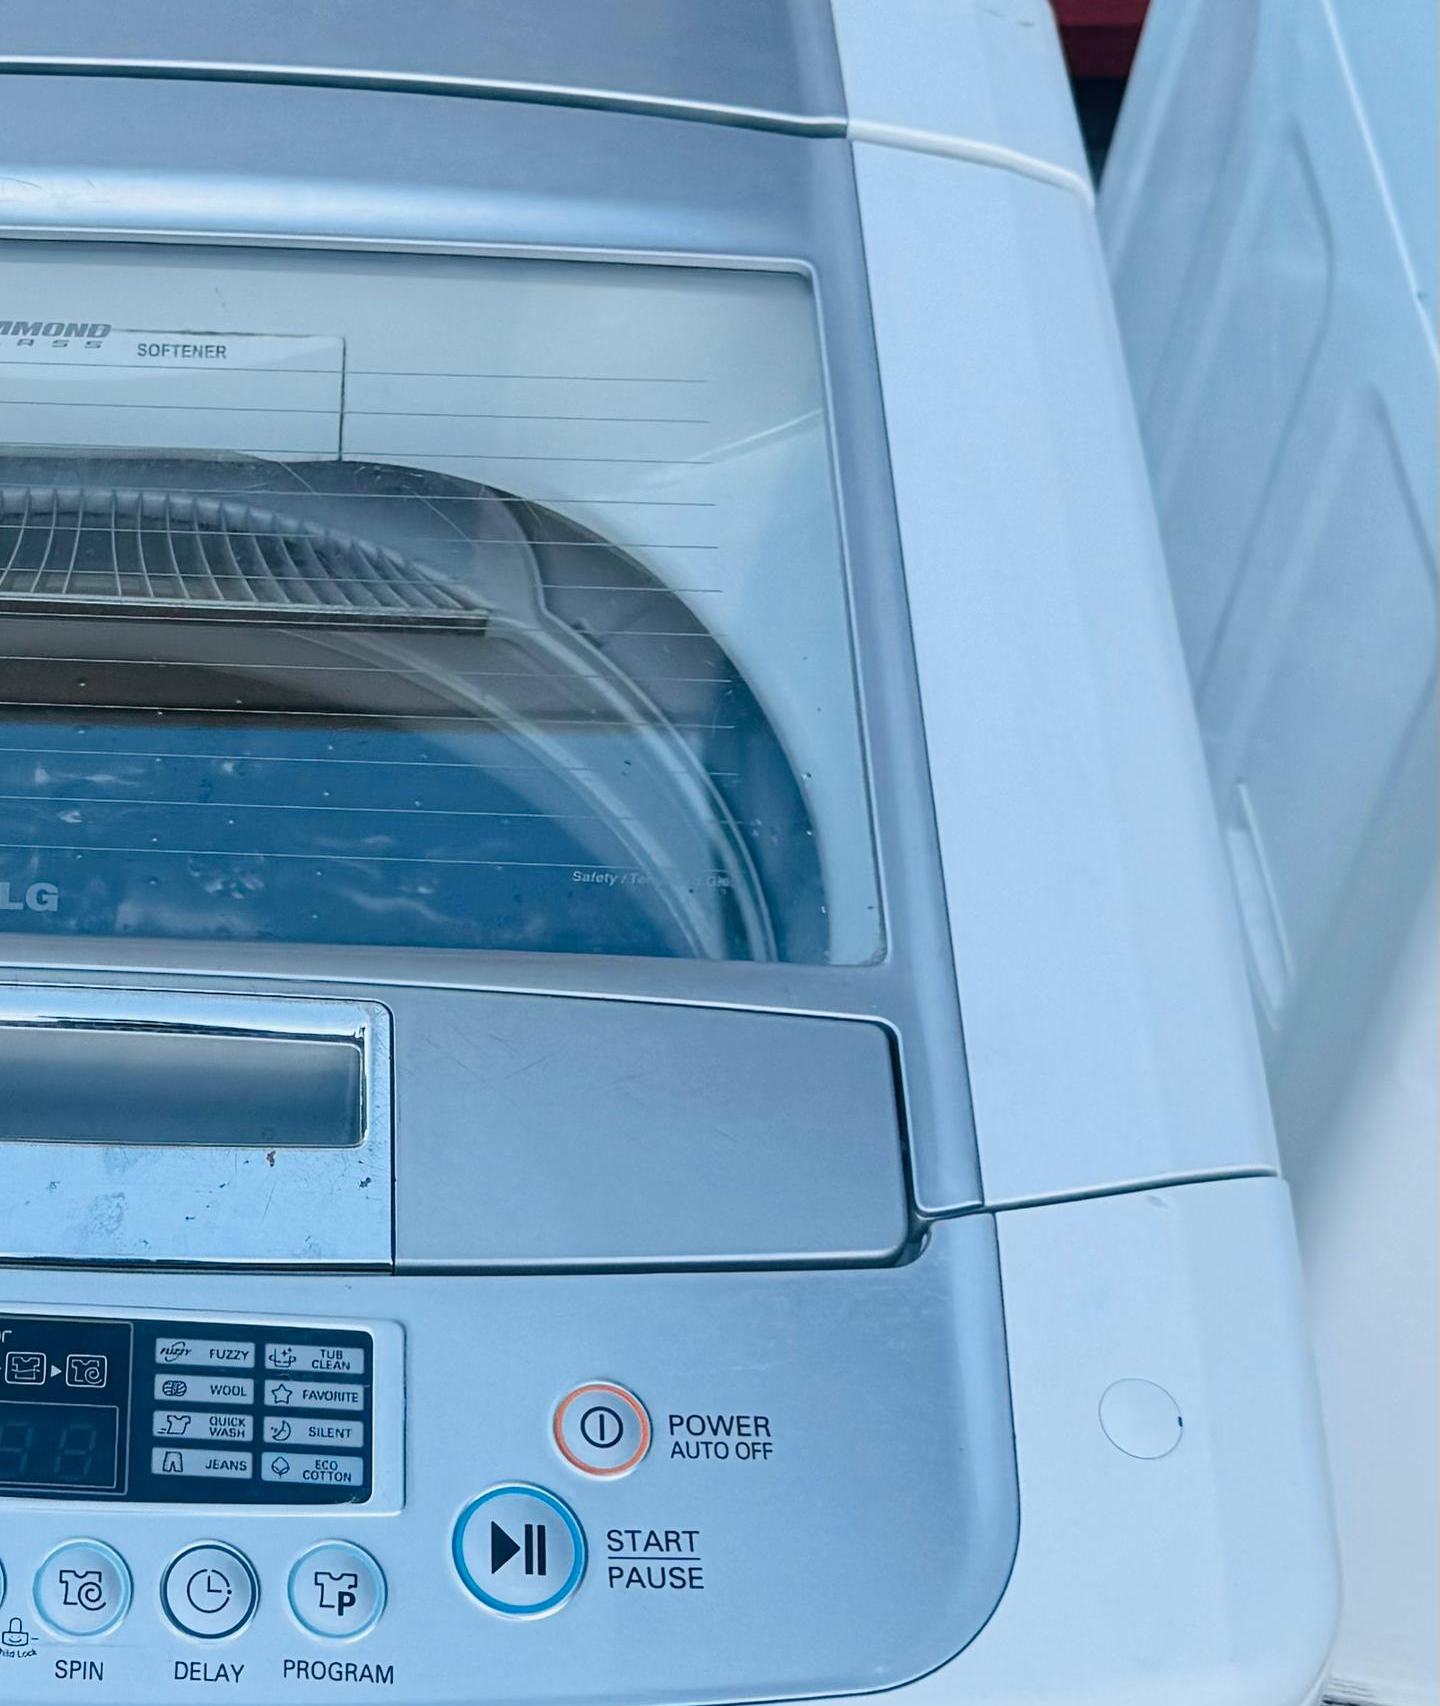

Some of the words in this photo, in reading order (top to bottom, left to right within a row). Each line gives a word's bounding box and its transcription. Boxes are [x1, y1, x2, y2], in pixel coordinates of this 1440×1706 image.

[137, 343, 227, 360] SOFTENER
[209, 1348, 249, 1361] FUZZY
[320, 1349, 344, 1359] TUB
[311, 1359, 351, 1371] CLEAN
[210, 1384, 247, 1397] WOOL
[301, 1390, 359, 1404] FAVORITE
[208, 1415, 246, 1428] QUICK
[668, 1414, 771, 1438] POWER
[208, 1426, 246, 1439] WASH
[308, 1426, 352, 1439] SILENT
[670, 1441, 729, 1460] AUTO
[735, 1442, 774, 1461] OFF
[205, 1459, 248, 1472] JEANS
[315, 1460, 338, 1471] ECO
[302, 1471, 352, 1483] COTTON
[606, 1529, 701, 1553] START
[607, 1566, 705, 1590] PAUSE
[54, 1660, 104, 1681] SPIN
[174, 1661, 245, 1684] DELAY
[283, 1659, 395, 1685] PROGRAM
